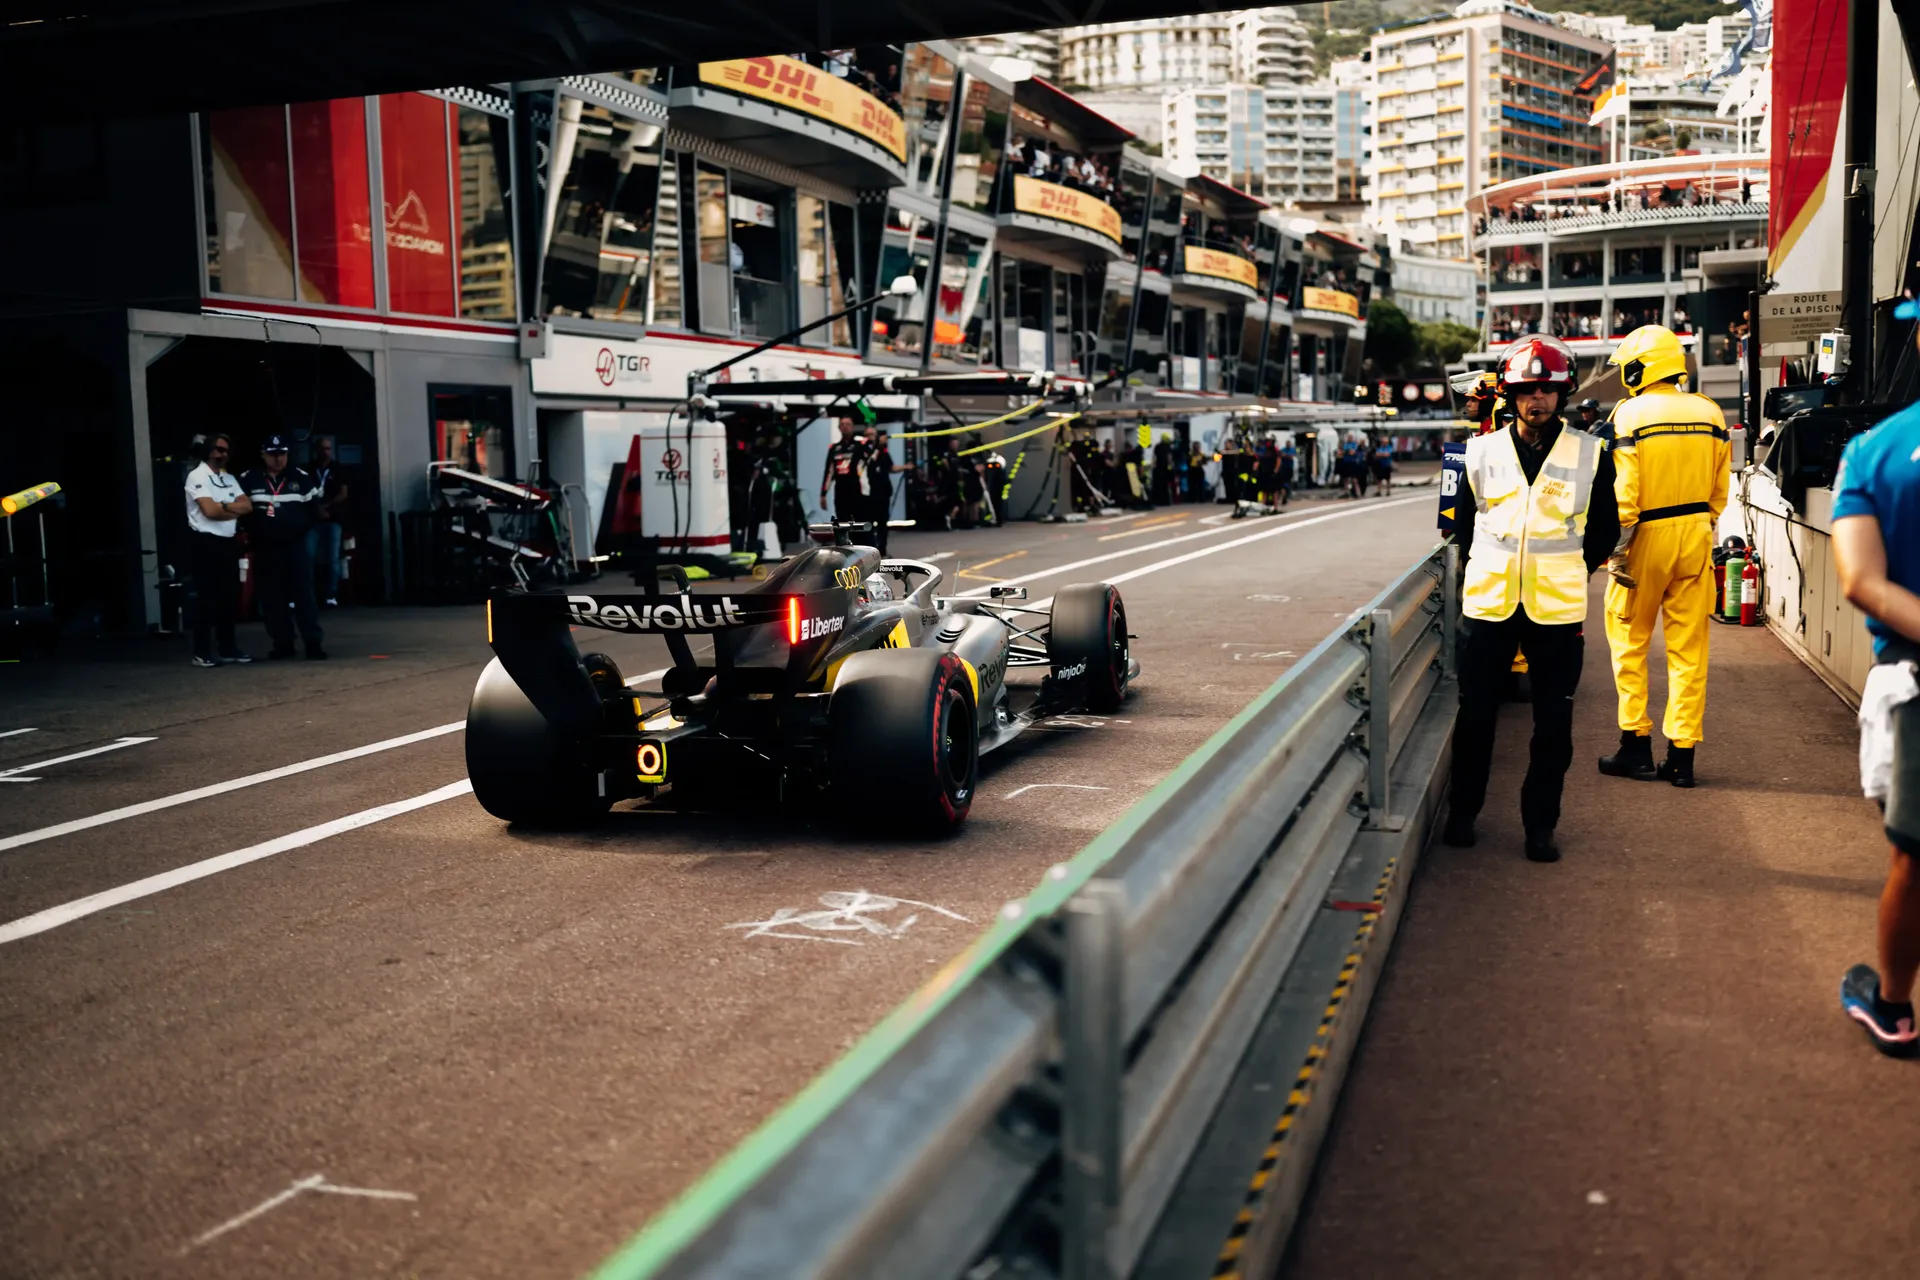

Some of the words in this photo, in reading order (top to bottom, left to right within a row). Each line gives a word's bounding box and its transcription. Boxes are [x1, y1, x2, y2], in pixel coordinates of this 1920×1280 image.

[743, 57, 821, 106] DHL
[861, 99, 896, 145] DHL
[1040, 187, 1080, 215] DHL
[1202, 253, 1231, 273] DHL
[1772, 308, 1785, 316] DE
[1790, 307, 1801, 315] LA
[1793, 294, 1827, 303] ROUTE
[617, 354, 650, 373] TGR
[1441, 469, 1463, 496] B
[567, 595, 745, 629] Revolut
[810, 614, 845, 639] Libertex
